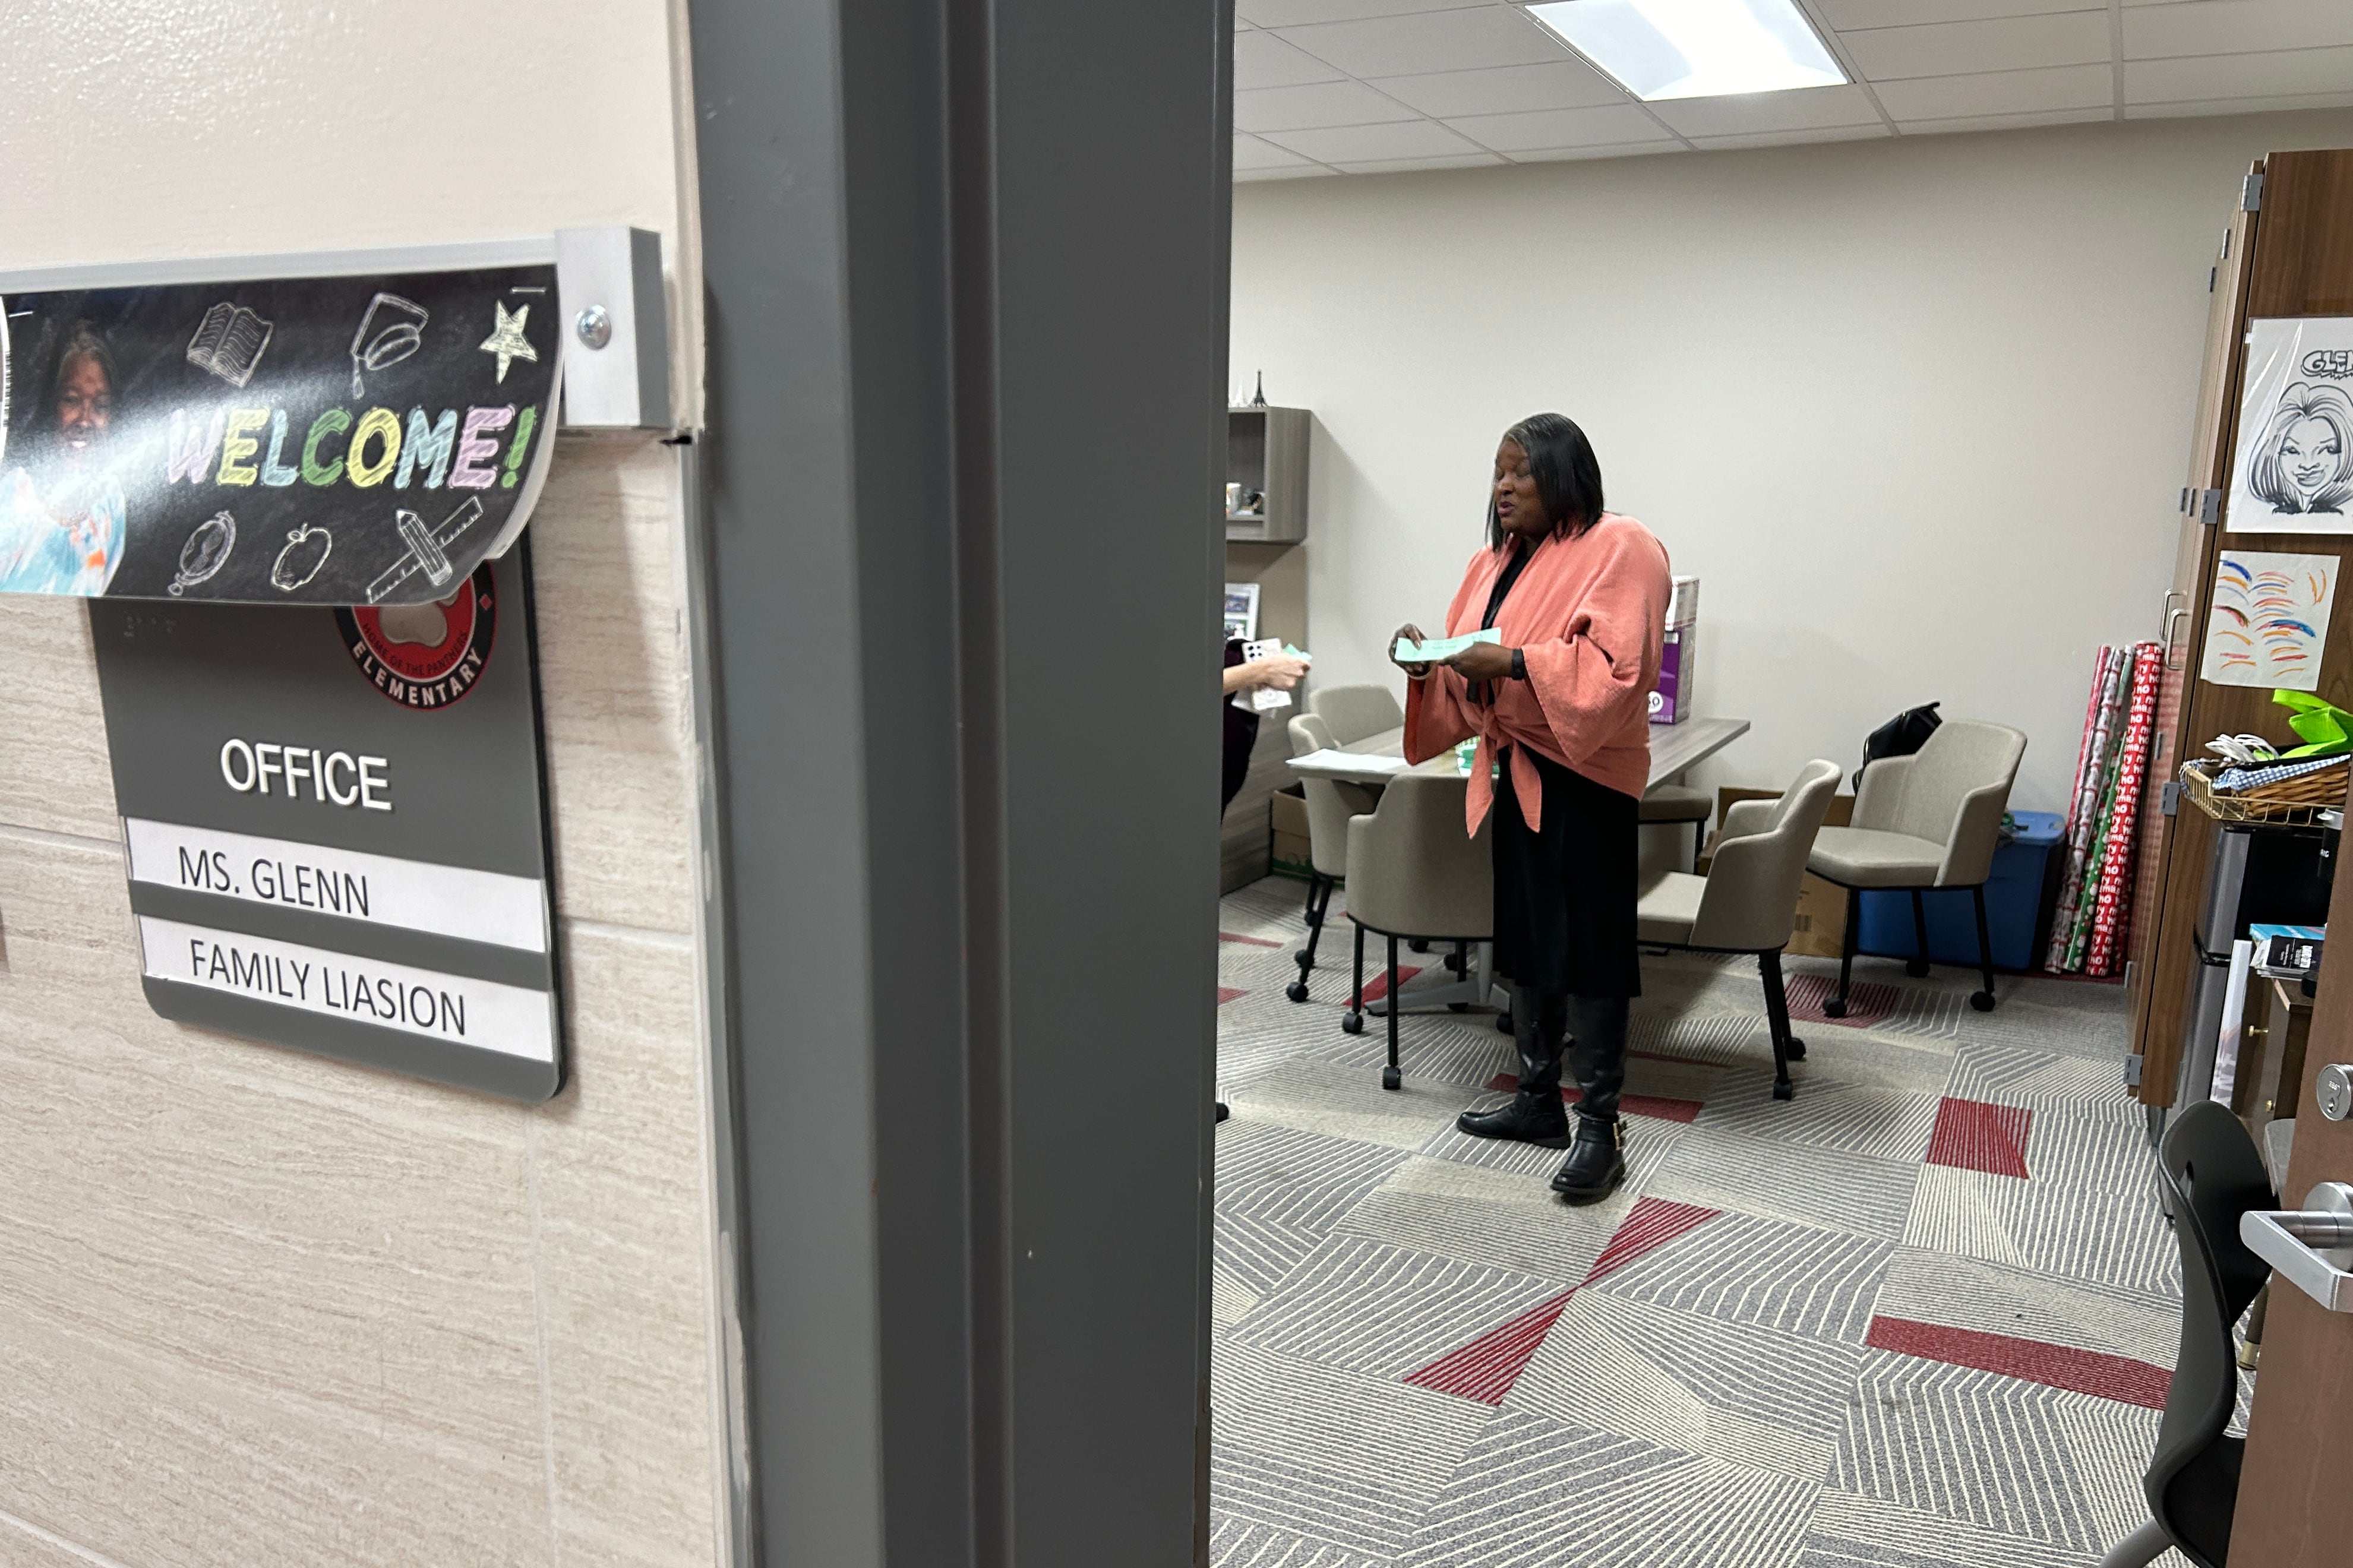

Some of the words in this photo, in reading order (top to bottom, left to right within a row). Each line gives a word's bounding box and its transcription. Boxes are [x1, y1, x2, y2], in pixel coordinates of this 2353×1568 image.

[166, 405, 536, 489] WELCOME!
[353, 641, 482, 706] ELEMENTARY
[363, 624, 389, 656] HOME
[390, 655, 403, 671] OF
[406, 662, 424, 676] THE
[427, 631, 468, 675] PANTHERS
[220, 738, 392, 811] OFFICE
[179, 846, 240, 894] MS.
[252, 858, 369, 916] GLENN
[190, 939, 309, 1000] FAMILY
[323, 967, 466, 1036] LIASION
